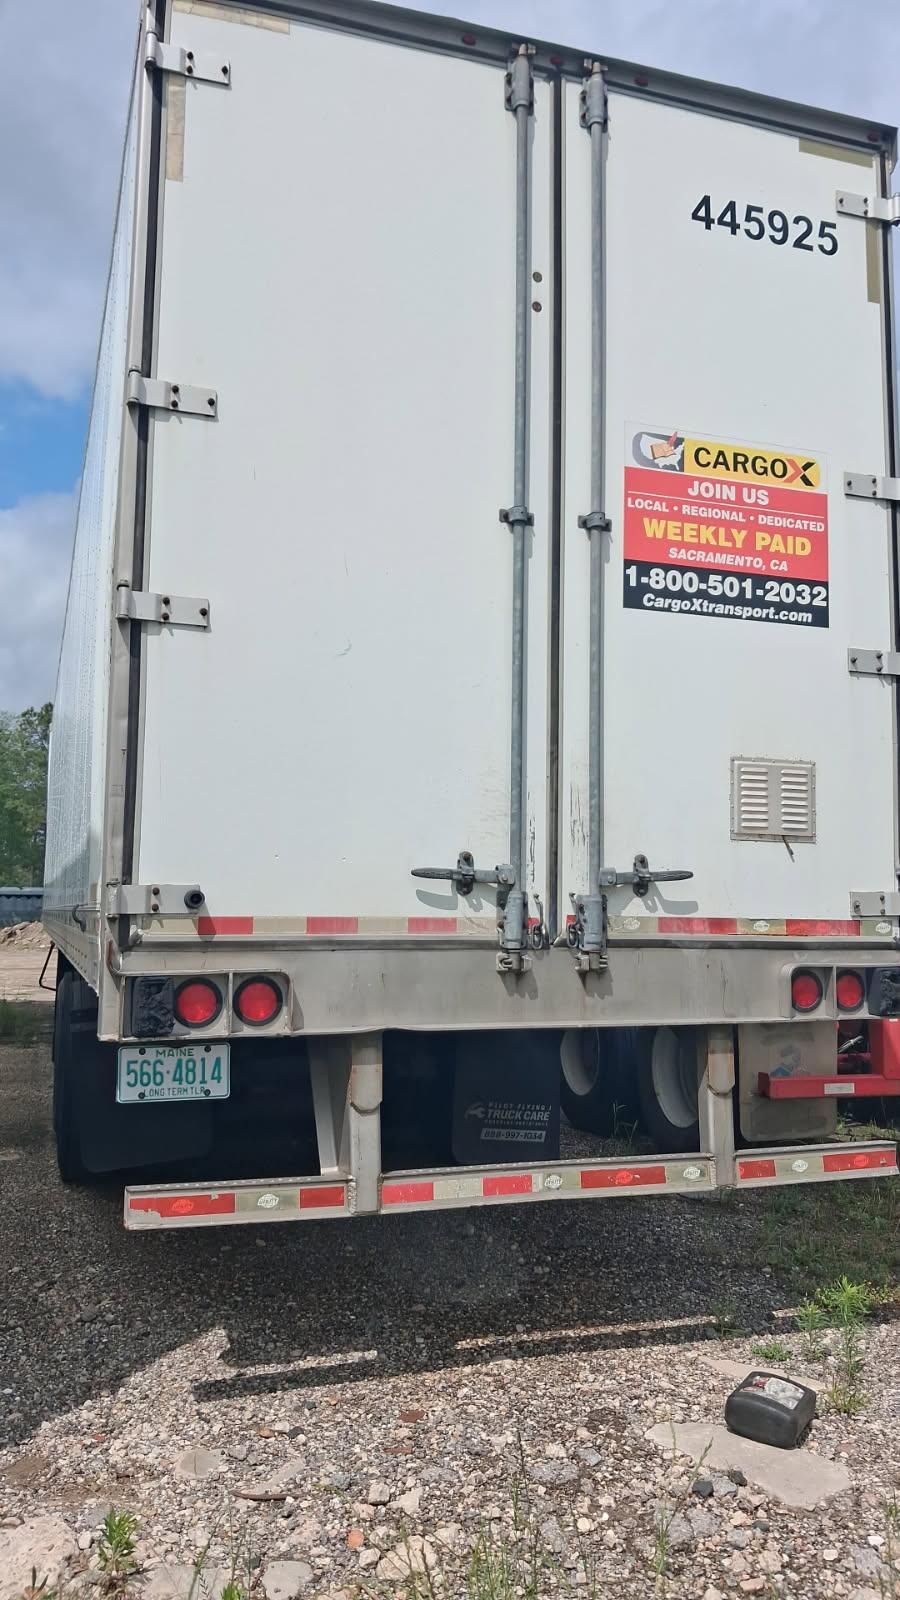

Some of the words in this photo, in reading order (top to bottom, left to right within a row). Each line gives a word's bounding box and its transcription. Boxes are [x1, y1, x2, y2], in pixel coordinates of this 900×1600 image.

[691, 194, 839, 256] 445925
[693, 446, 816, 487] CARGOX
[687, 480, 736, 503] JOIN
[742, 488, 769, 506] US
[627, 497, 669, 513] LOCAL
[682, 504, 746, 522] REGIONAL
[758, 514, 825, 532] DEDICATED
[643, 517, 747, 548] WEEKLY
[755, 531, 812, 556] PAID
[668, 548, 766, 570] SACRAMENTO,
[770, 560, 788, 571] CA
[625, 565, 827, 607] 1-800-501-2032
[643, 593, 813, 623] CargoXtransport.com
[155, 1048, 195, 1058] MAINE
[143, 1088, 165, 1098] LONG
[168, 1087, 188, 1097] TERM
[486, 1109, 522, 1120] TRUCK
[523, 1111, 551, 1121] CARE
